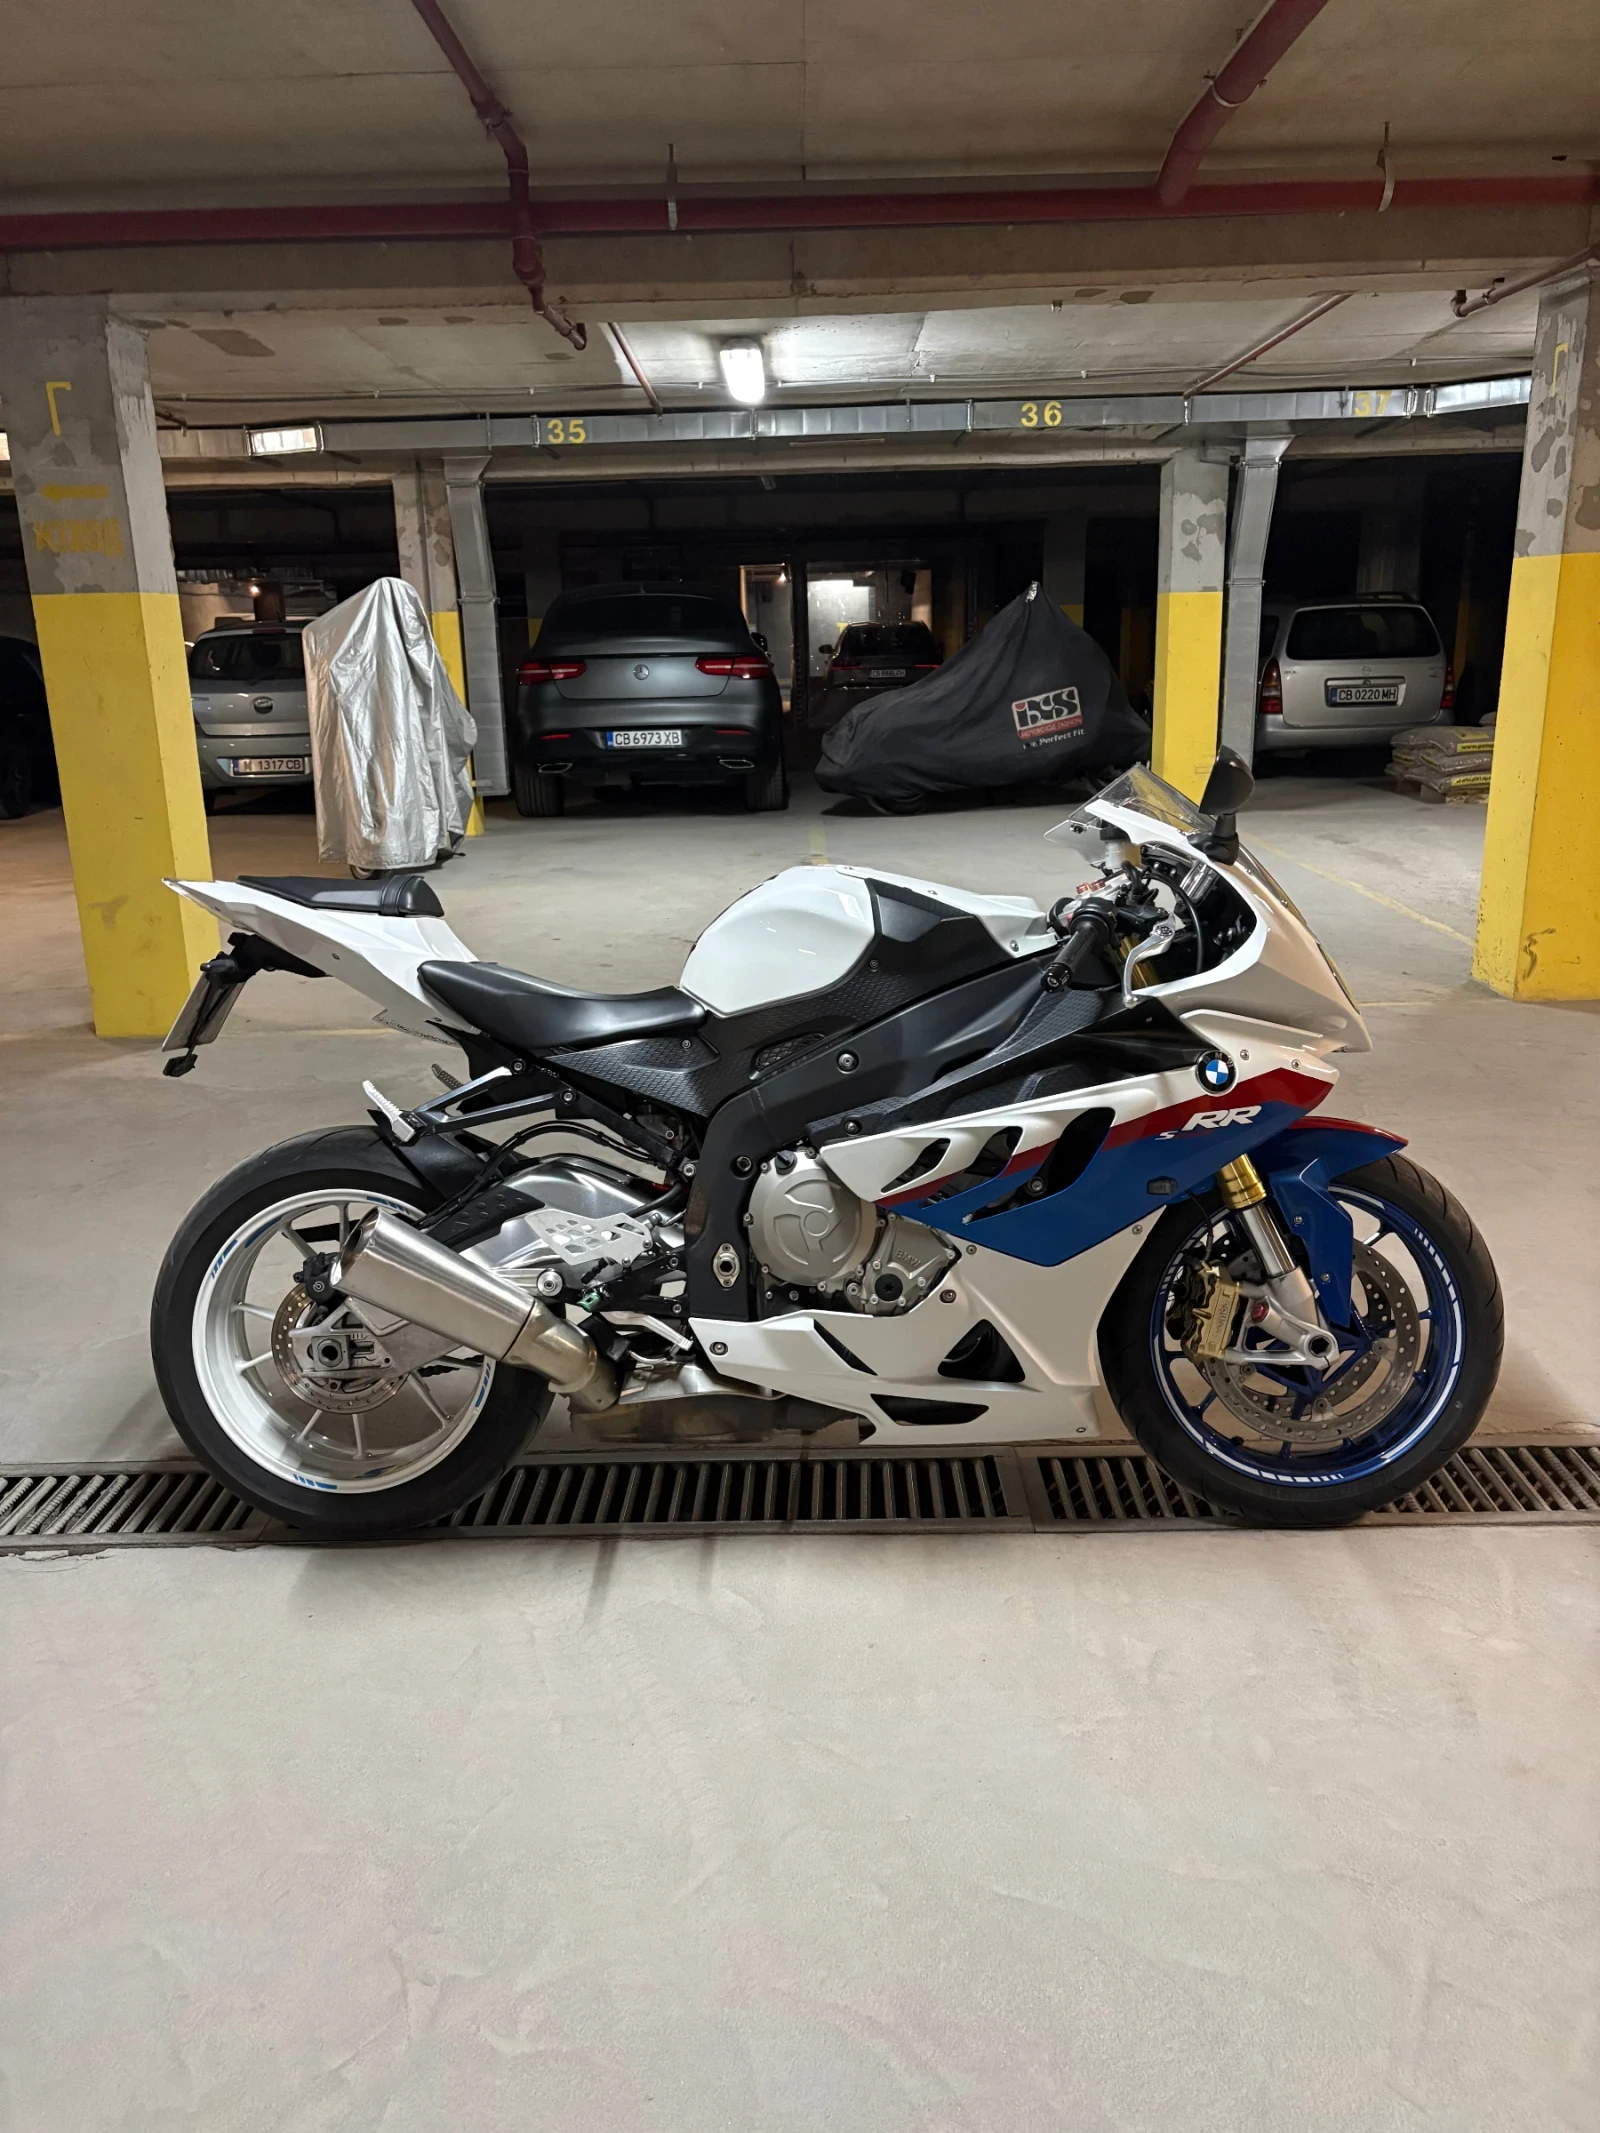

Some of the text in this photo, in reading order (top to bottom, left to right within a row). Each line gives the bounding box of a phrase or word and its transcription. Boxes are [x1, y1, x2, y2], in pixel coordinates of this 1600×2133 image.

[1354, 390, 1393, 417] 37
[1021, 401, 1062, 428] 36
[547, 419, 586, 444] 35
[1338, 688, 1397, 701] CB 0220 MH
[614, 731, 681, 746] CB 6973 XB
[1039, 731, 1072, 746] Perfect
[1073, 728, 1085, 738] Fit
[258, 759, 285, 771] 1317
[285, 759, 301, 770] CB
[1203, 1052, 1234, 1068] BMW
[1181, 1105, 1262, 1131] RR
[895, 1248, 922, 1268] BMW
